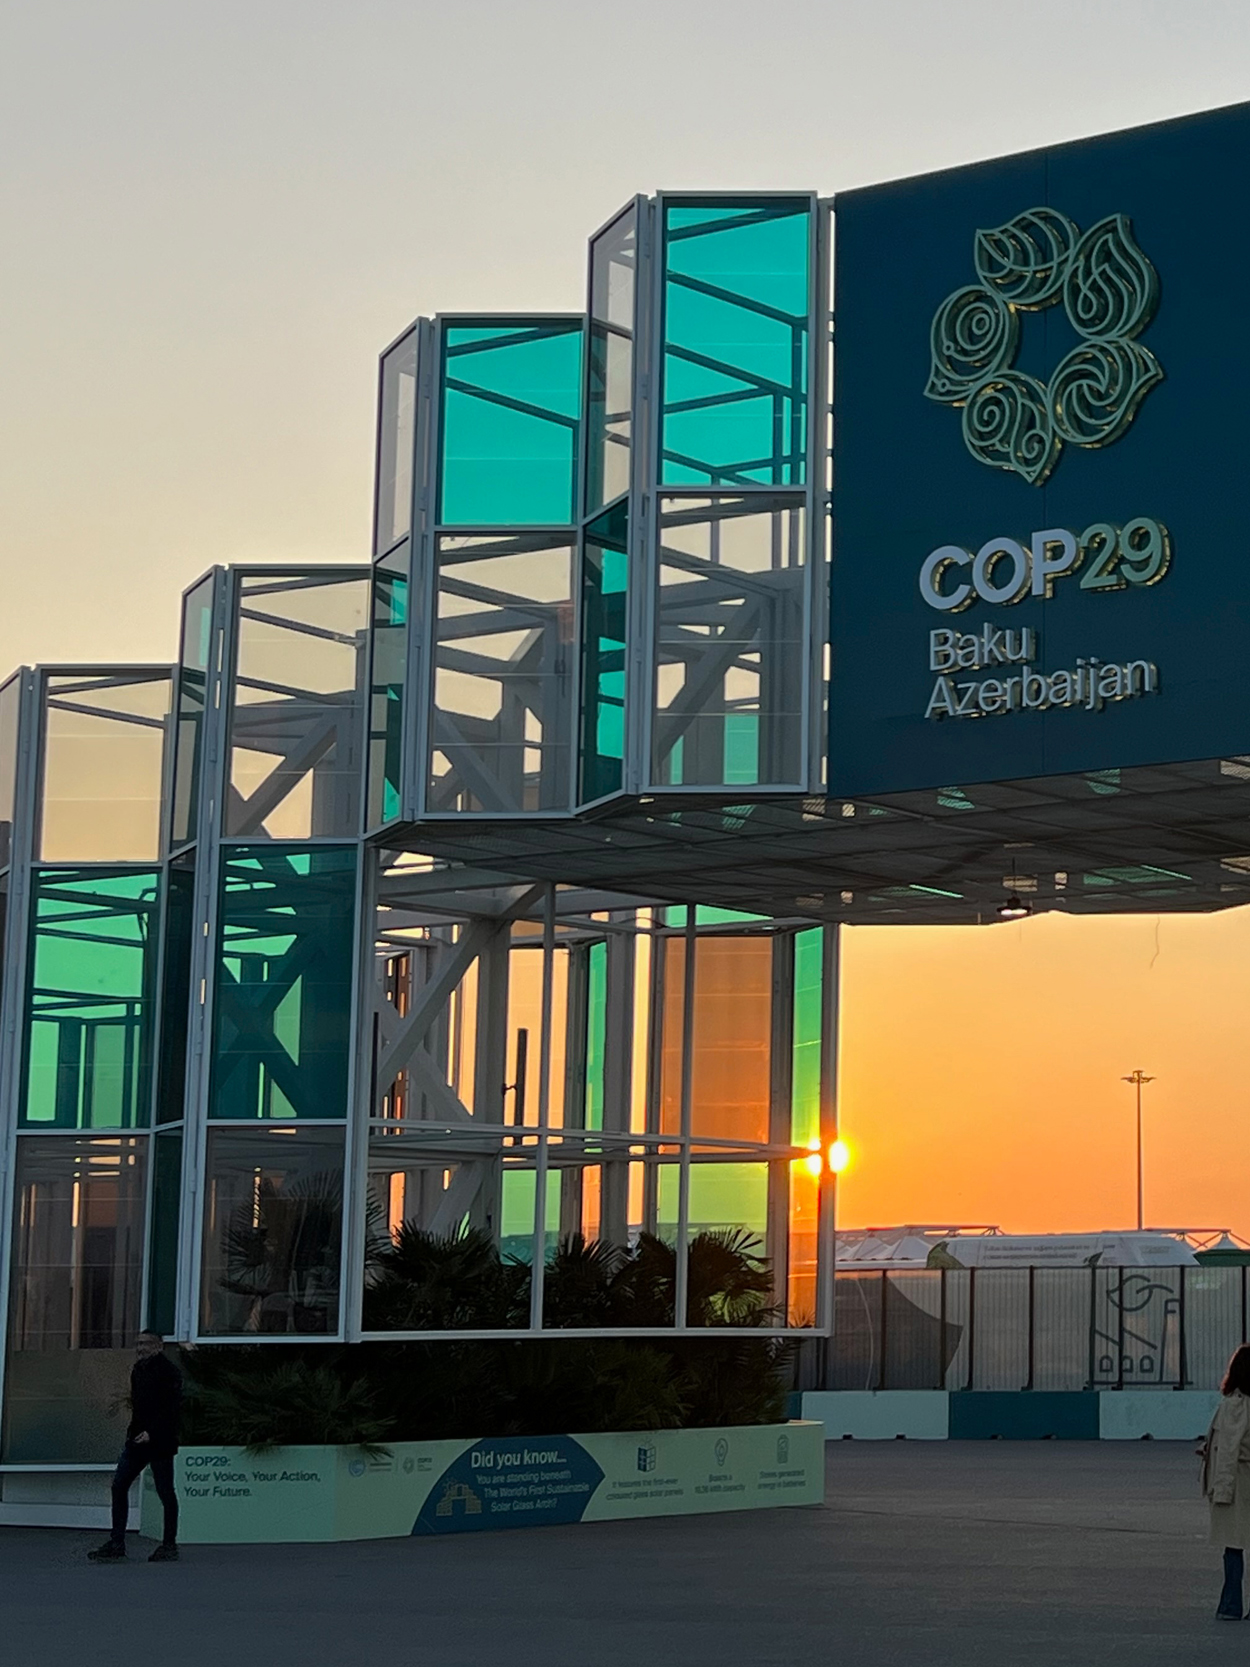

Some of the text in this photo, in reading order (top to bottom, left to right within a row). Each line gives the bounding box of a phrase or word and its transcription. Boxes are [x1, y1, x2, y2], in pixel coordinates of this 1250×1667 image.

[919, 516, 1170, 612] COP29
[929, 622, 1034, 674] Baku
[924, 656, 1158, 719] Azerbaijan
[185, 1455, 231, 1467] COP29:
[471, 1450, 495, 1468] Did
[496, 1452, 521, 1470] you
[184, 1470, 321, 1483] Your Voice, Your Action,
[476, 1473, 491, 1484] You
[492, 1475, 505, 1484] are
[506, 1471, 539, 1483] standing
[184, 1486, 252, 1497] Your Future.
[484, 1487, 498, 1498] The
[529, 1484, 545, 1495] First
[491, 1501, 512, 1513] Solar
[512, 1500, 534, 1511] Glass
